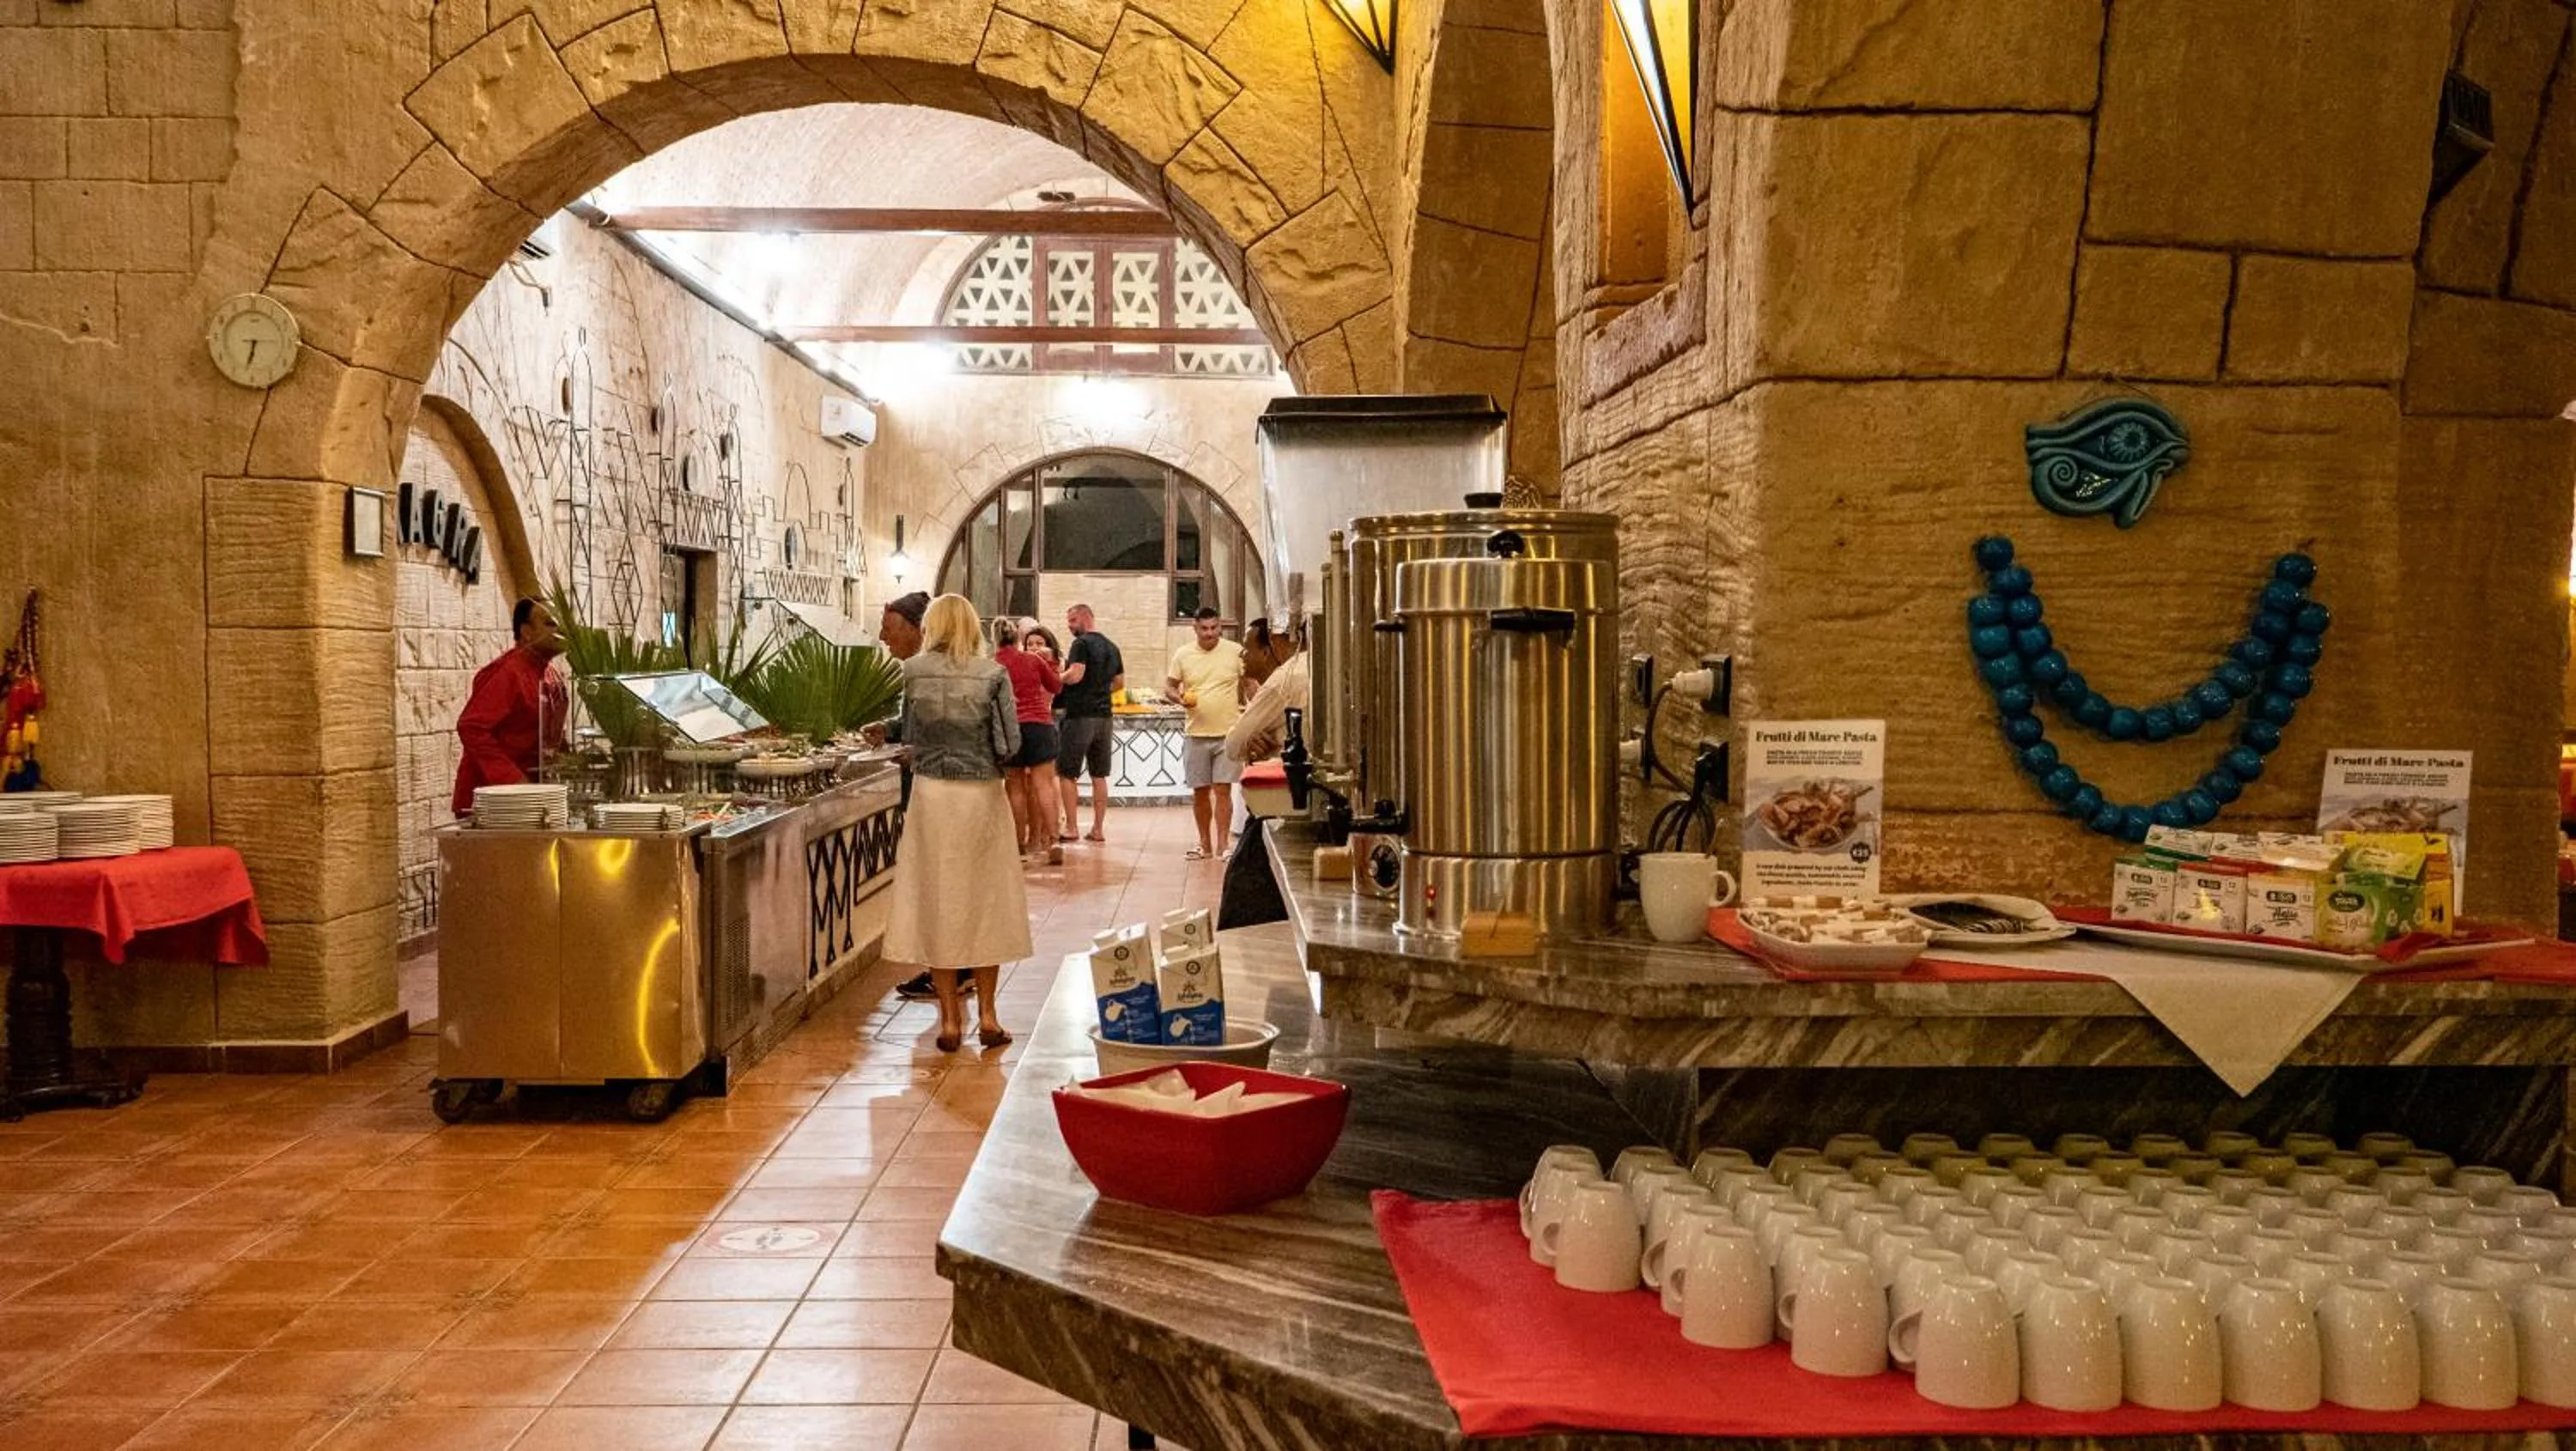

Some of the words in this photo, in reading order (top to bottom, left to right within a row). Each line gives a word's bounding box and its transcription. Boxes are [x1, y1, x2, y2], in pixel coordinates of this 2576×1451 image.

[397, 483, 482, 585] AGRA
[1756, 731, 1791, 742] Frutti
[1794, 731, 1806, 742] di
[1808, 732, 1840, 742] Mare
[1844, 732, 1877, 742] Pasta
[2334, 756, 2372, 766] Frutti
[2374, 756, 2387, 766] di
[2391, 757, 2424, 767] Mare
[2428, 758, 2464, 768] Pasta
